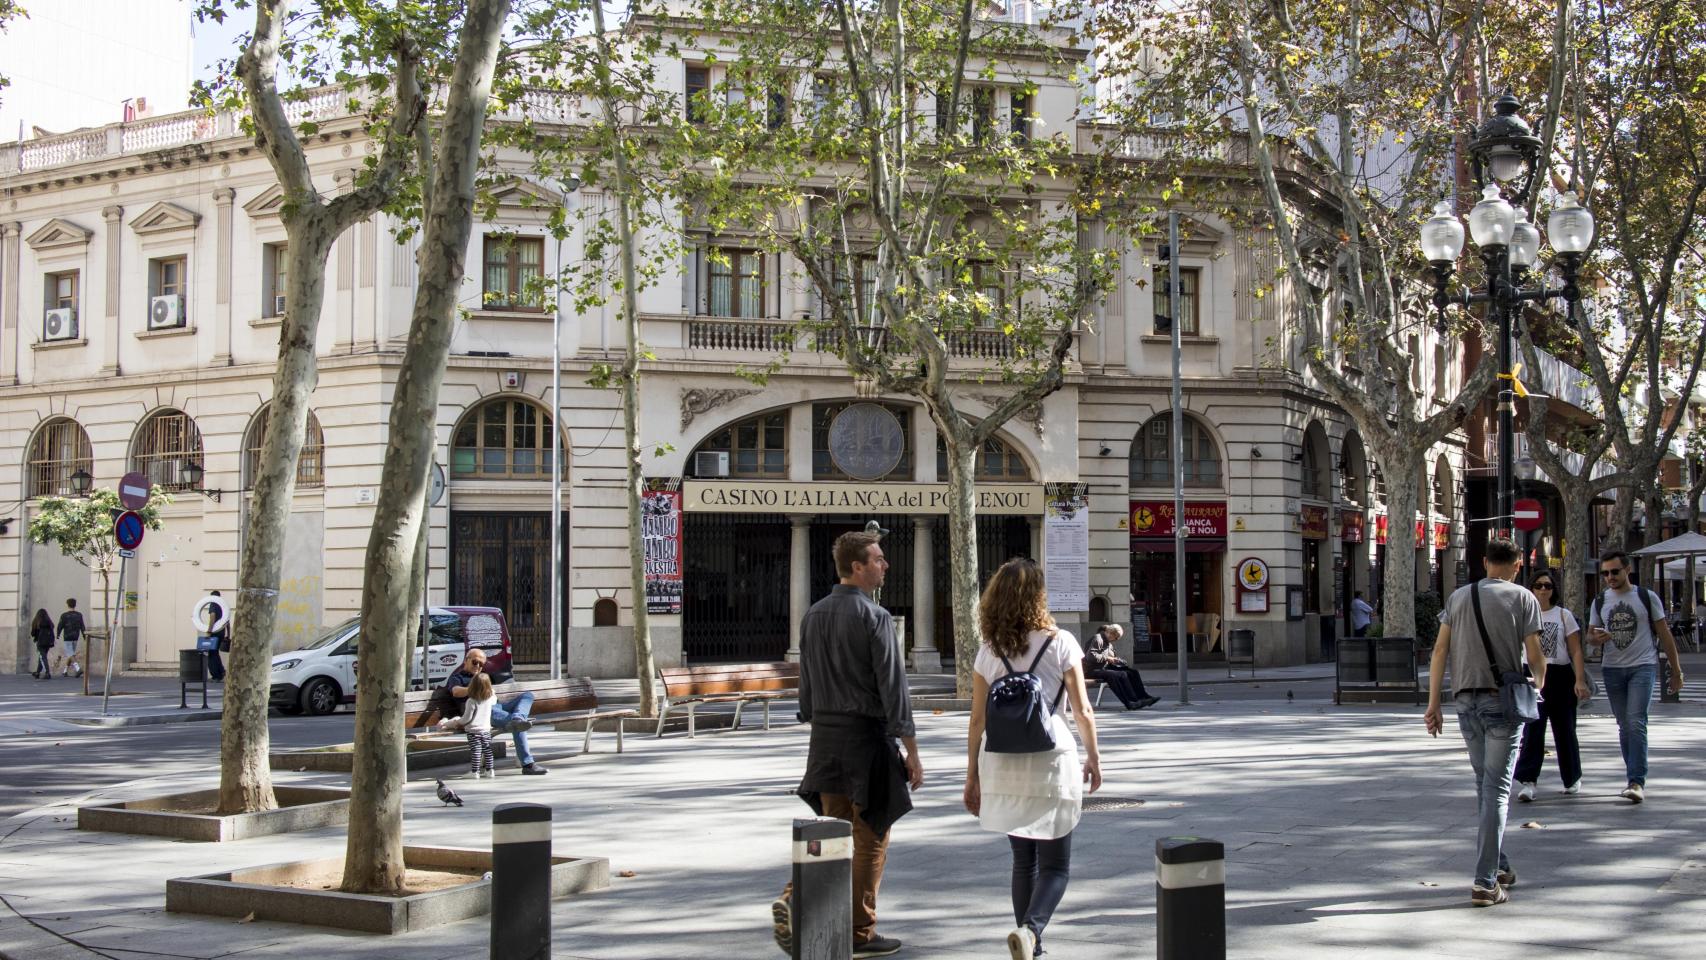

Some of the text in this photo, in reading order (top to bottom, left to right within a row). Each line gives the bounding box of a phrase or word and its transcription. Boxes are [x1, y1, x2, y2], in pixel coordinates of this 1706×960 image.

[700, 488, 1031, 511] CASINO L'ALIANÇA del POENOU
[642, 537, 677, 560] AMBO
[645, 561, 677, 574] RKESTRA
